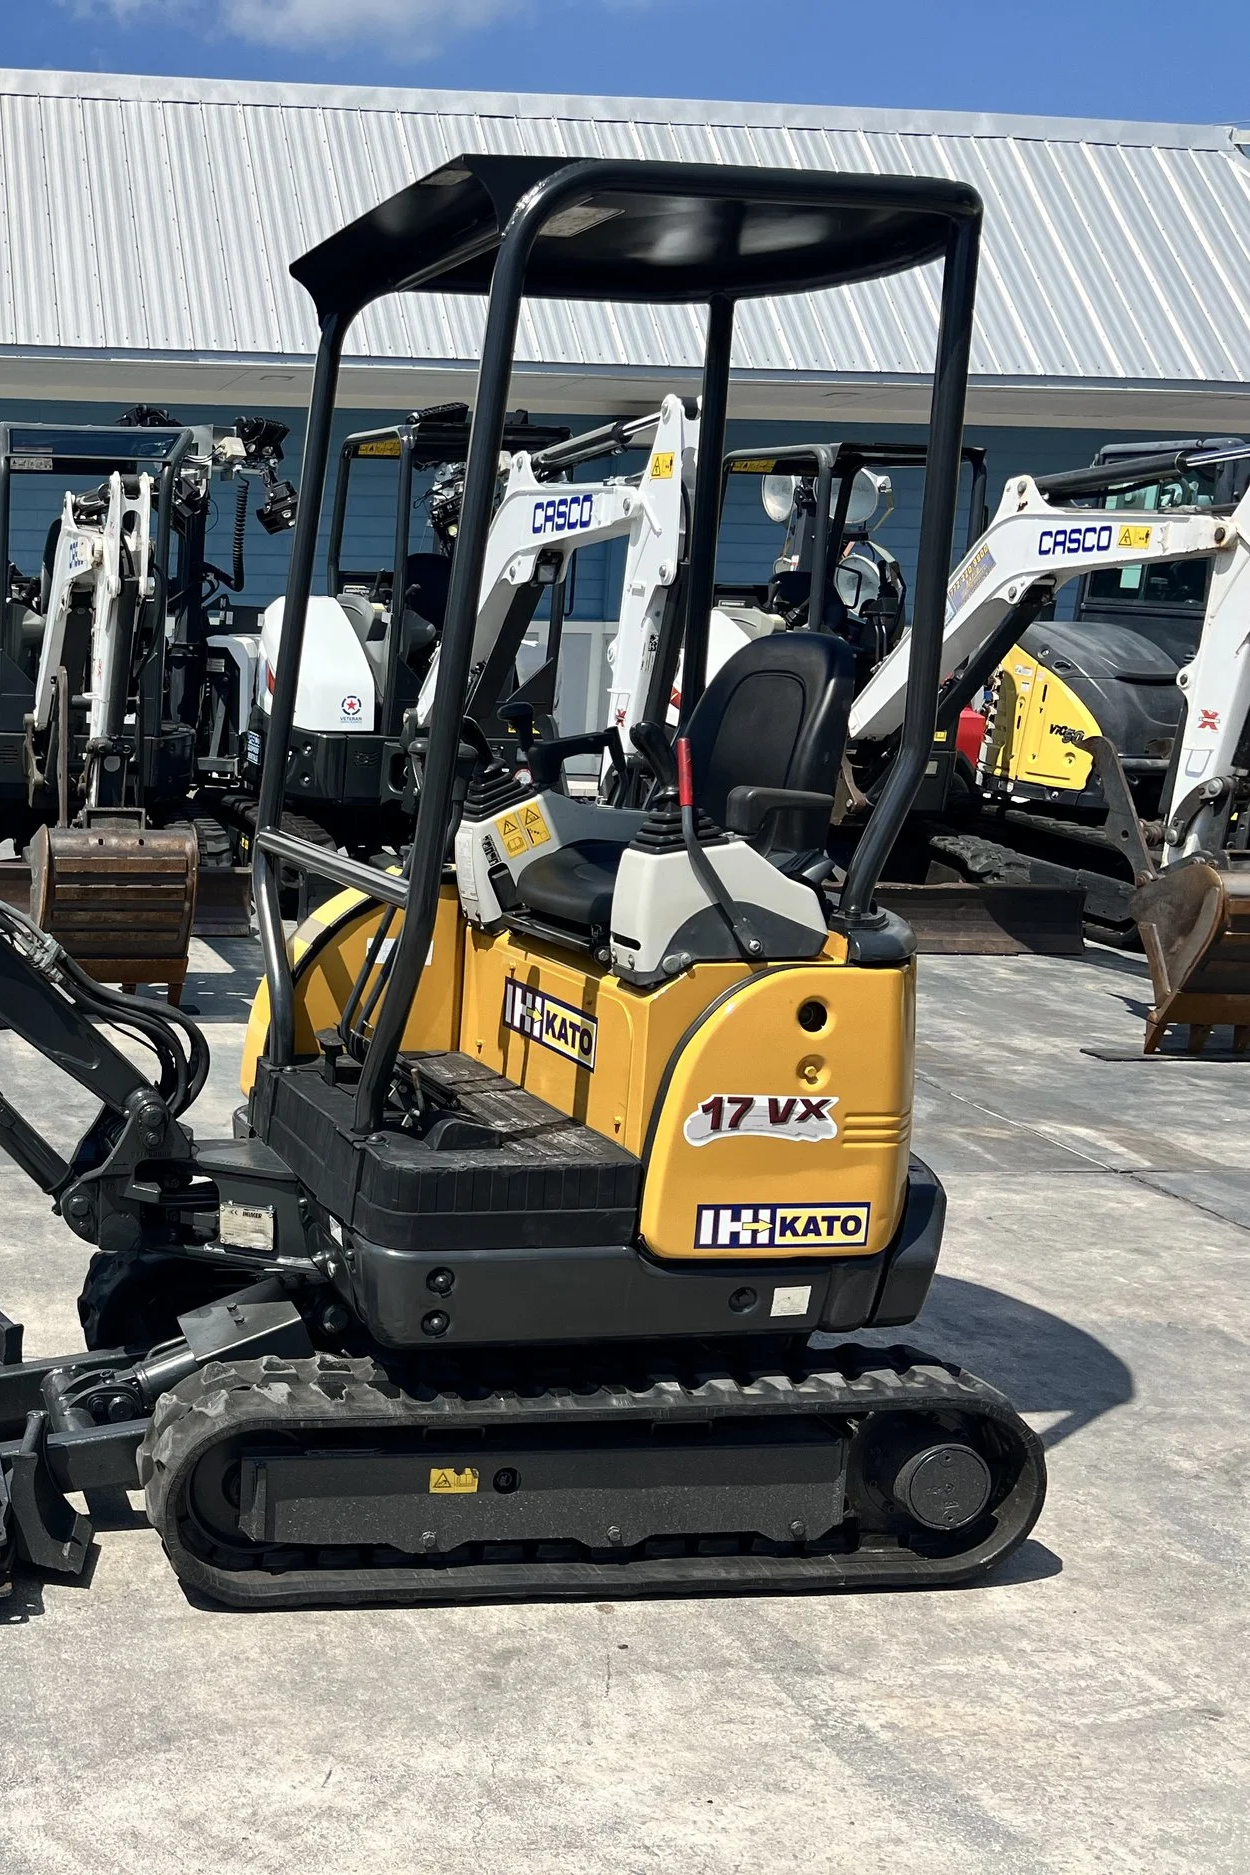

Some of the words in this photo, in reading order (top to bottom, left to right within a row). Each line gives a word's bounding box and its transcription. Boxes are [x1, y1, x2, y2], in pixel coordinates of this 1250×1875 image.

[532, 494, 593, 534] CASCO
[1038, 525, 1113, 556] CASCO
[545, 1009, 593, 1056] KATO
[702, 1097, 755, 1131] 17
[768, 1098, 832, 1125] VX
[779, 1215, 862, 1237] KATO
